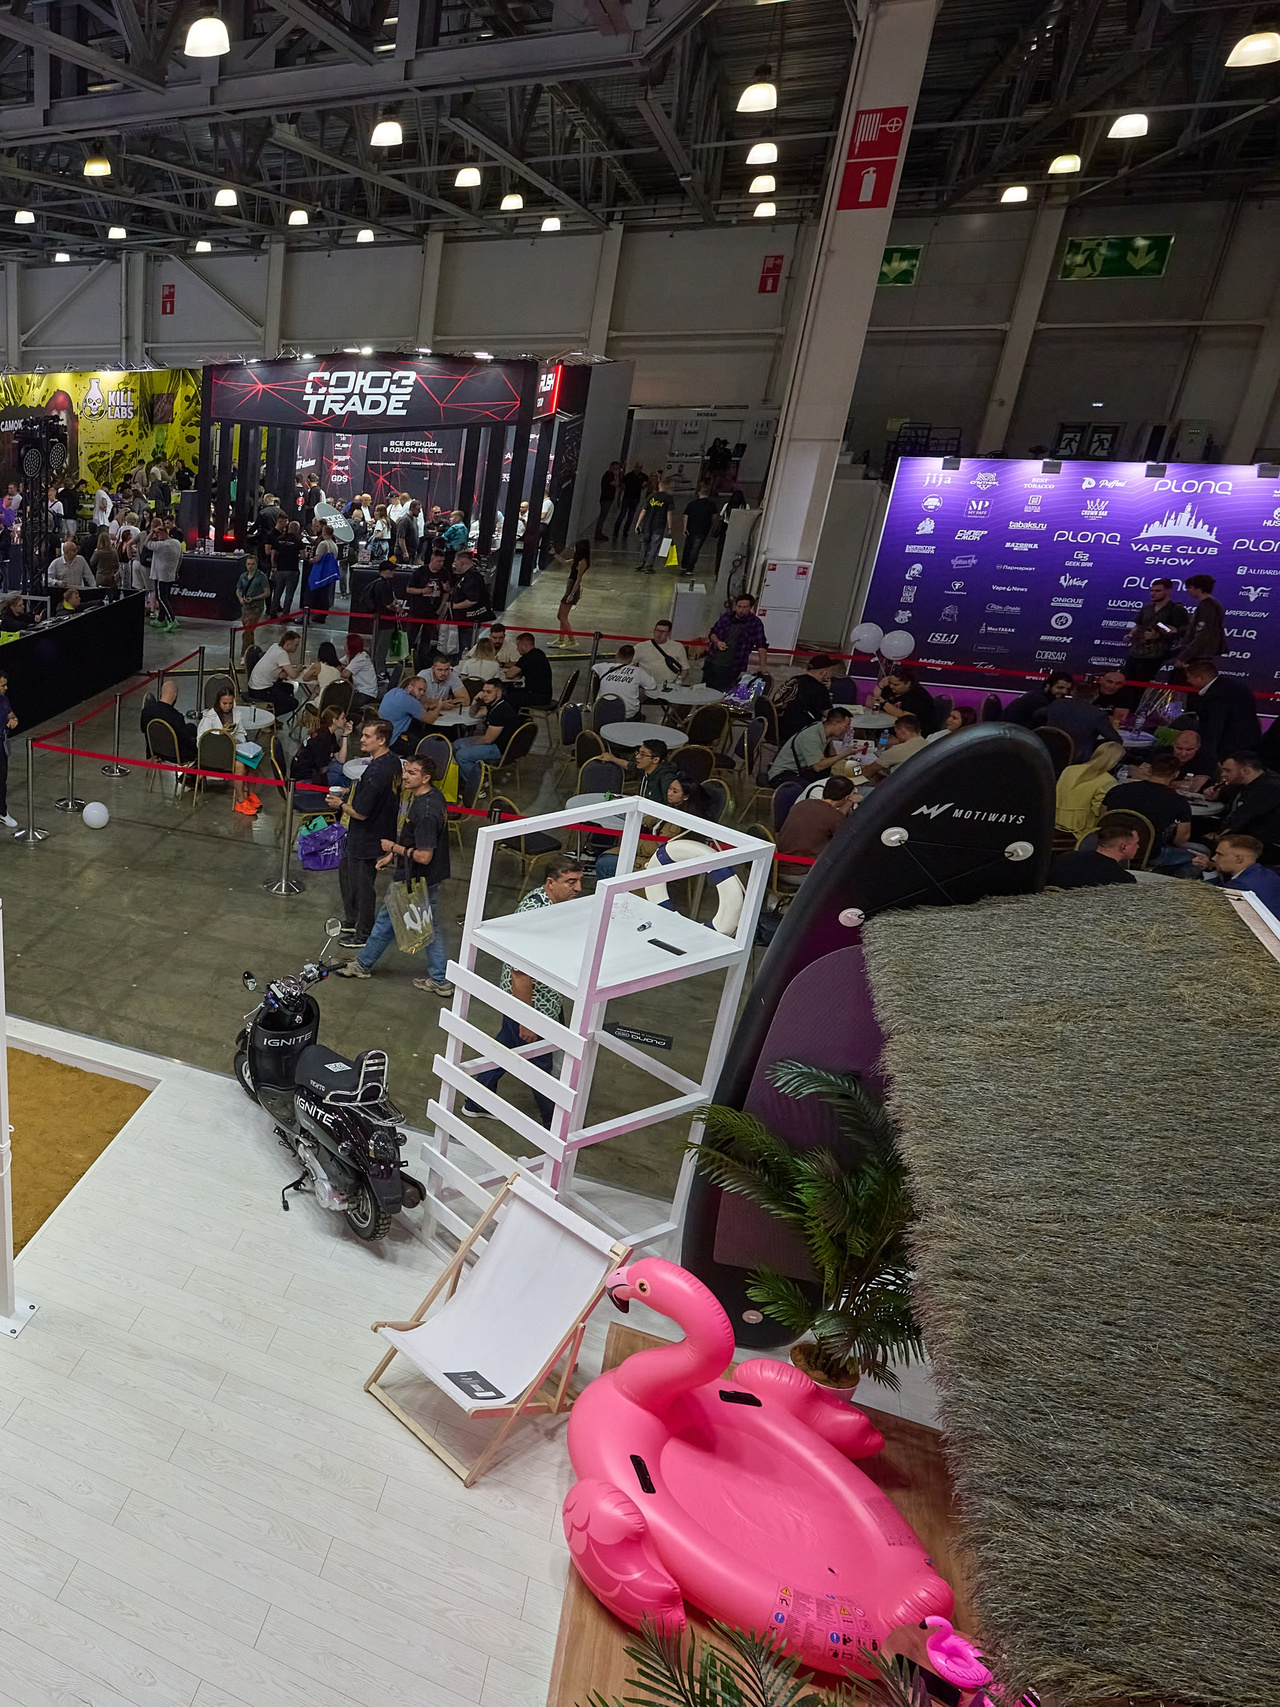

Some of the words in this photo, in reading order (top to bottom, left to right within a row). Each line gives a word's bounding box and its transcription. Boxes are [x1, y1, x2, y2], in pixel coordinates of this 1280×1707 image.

[304, 371, 416, 394] СОЮЗ
[108, 391, 134, 407] KILL
[303, 394, 411, 416] TRADE
[108, 406, 134, 420] LABS
[1154, 480, 1232, 495] PLONQ
[1054, 530, 1120, 545] PLONQ
[1131, 544, 1172, 553] VAPE
[1176, 546, 1218, 554] CLUB
[1144, 557, 1194, 566] SHOW
[1224, 628, 1258, 640] VLIQ
[1036, 650, 1066, 660] CORSAR
[952, 808, 1026, 824] MOTIWAYS
[264, 1031, 312, 1046] IGNITE
[296, 1096, 334, 1127] IGNITE
